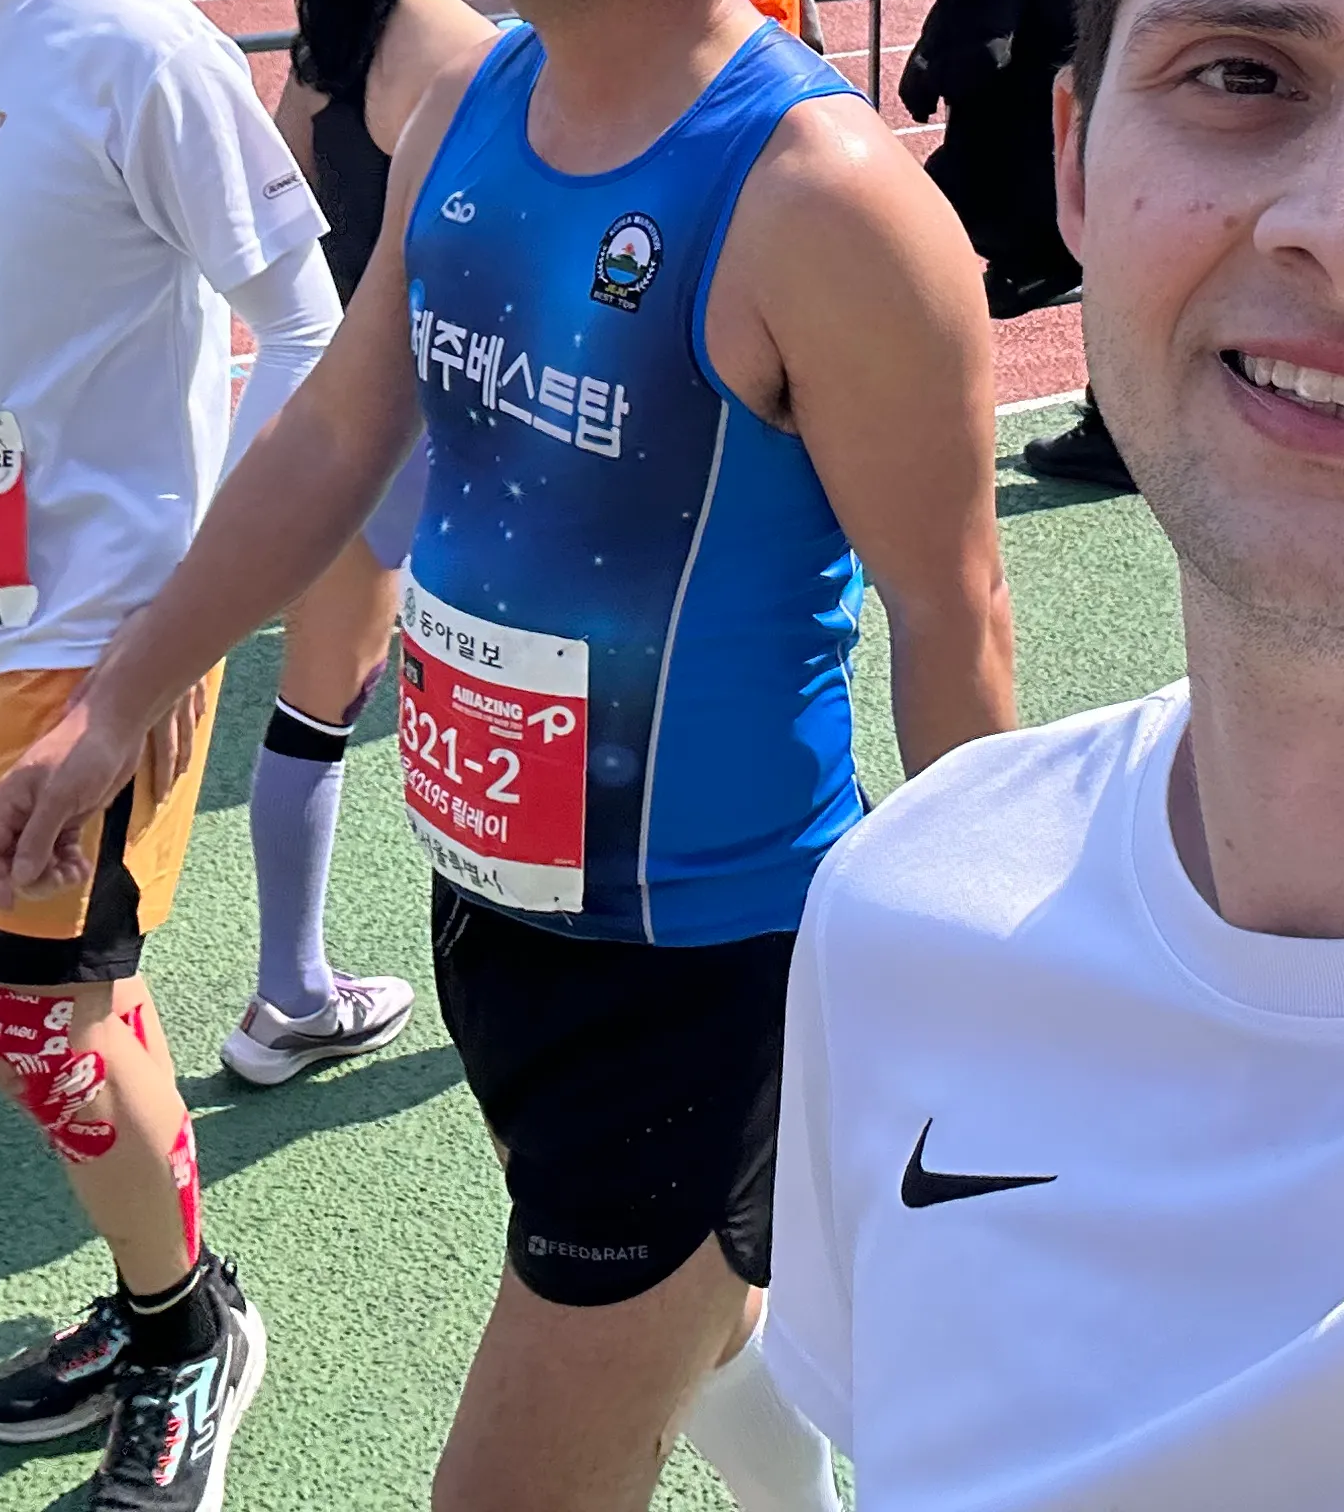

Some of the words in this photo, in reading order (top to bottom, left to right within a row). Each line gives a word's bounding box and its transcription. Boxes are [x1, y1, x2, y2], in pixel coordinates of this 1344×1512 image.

[419, 609, 504, 670] 동아일보
[400, 686, 522, 805] 321-2
[450, 795, 509, 844] 릴레이
[547, 1240, 649, 1262] FEED&RATE
